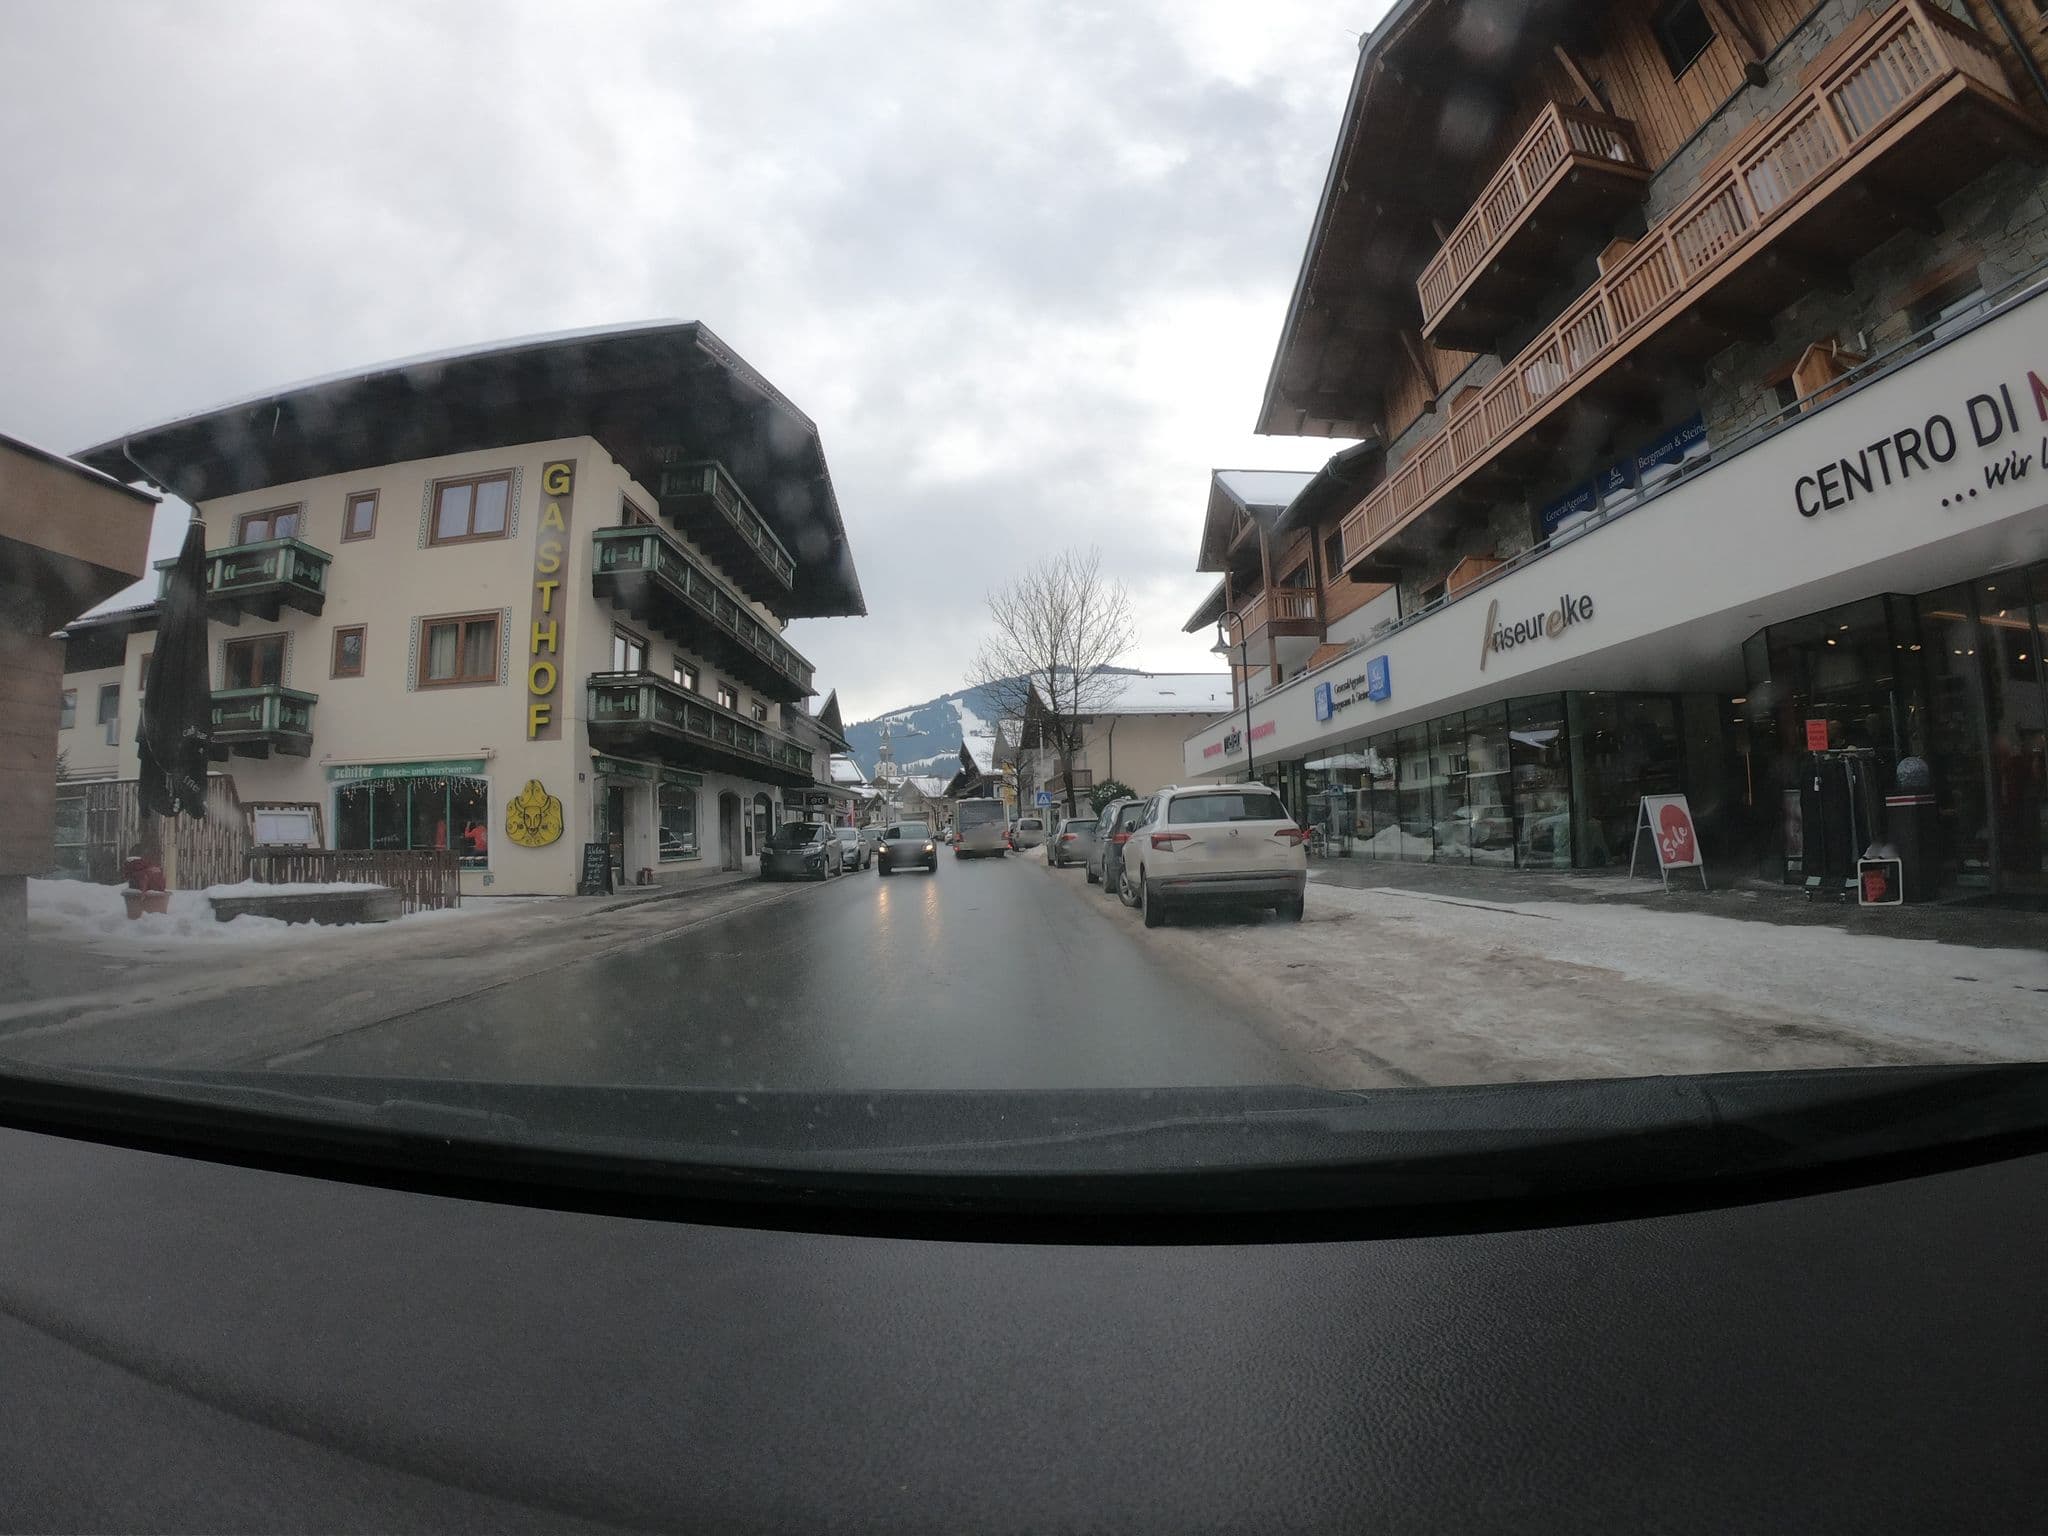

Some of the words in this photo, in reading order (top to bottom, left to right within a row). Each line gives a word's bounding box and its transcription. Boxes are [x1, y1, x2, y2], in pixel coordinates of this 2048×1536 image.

[1637, 442, 1674, 469] Bergmann
[1674, 436, 1681, 447] &
[1795, 414, 1957, 518] CENTRO
[1966, 383, 2020, 448] DI
[528, 463, 571, 738] GASTHOF
[1662, 825, 1688, 859] Sale
